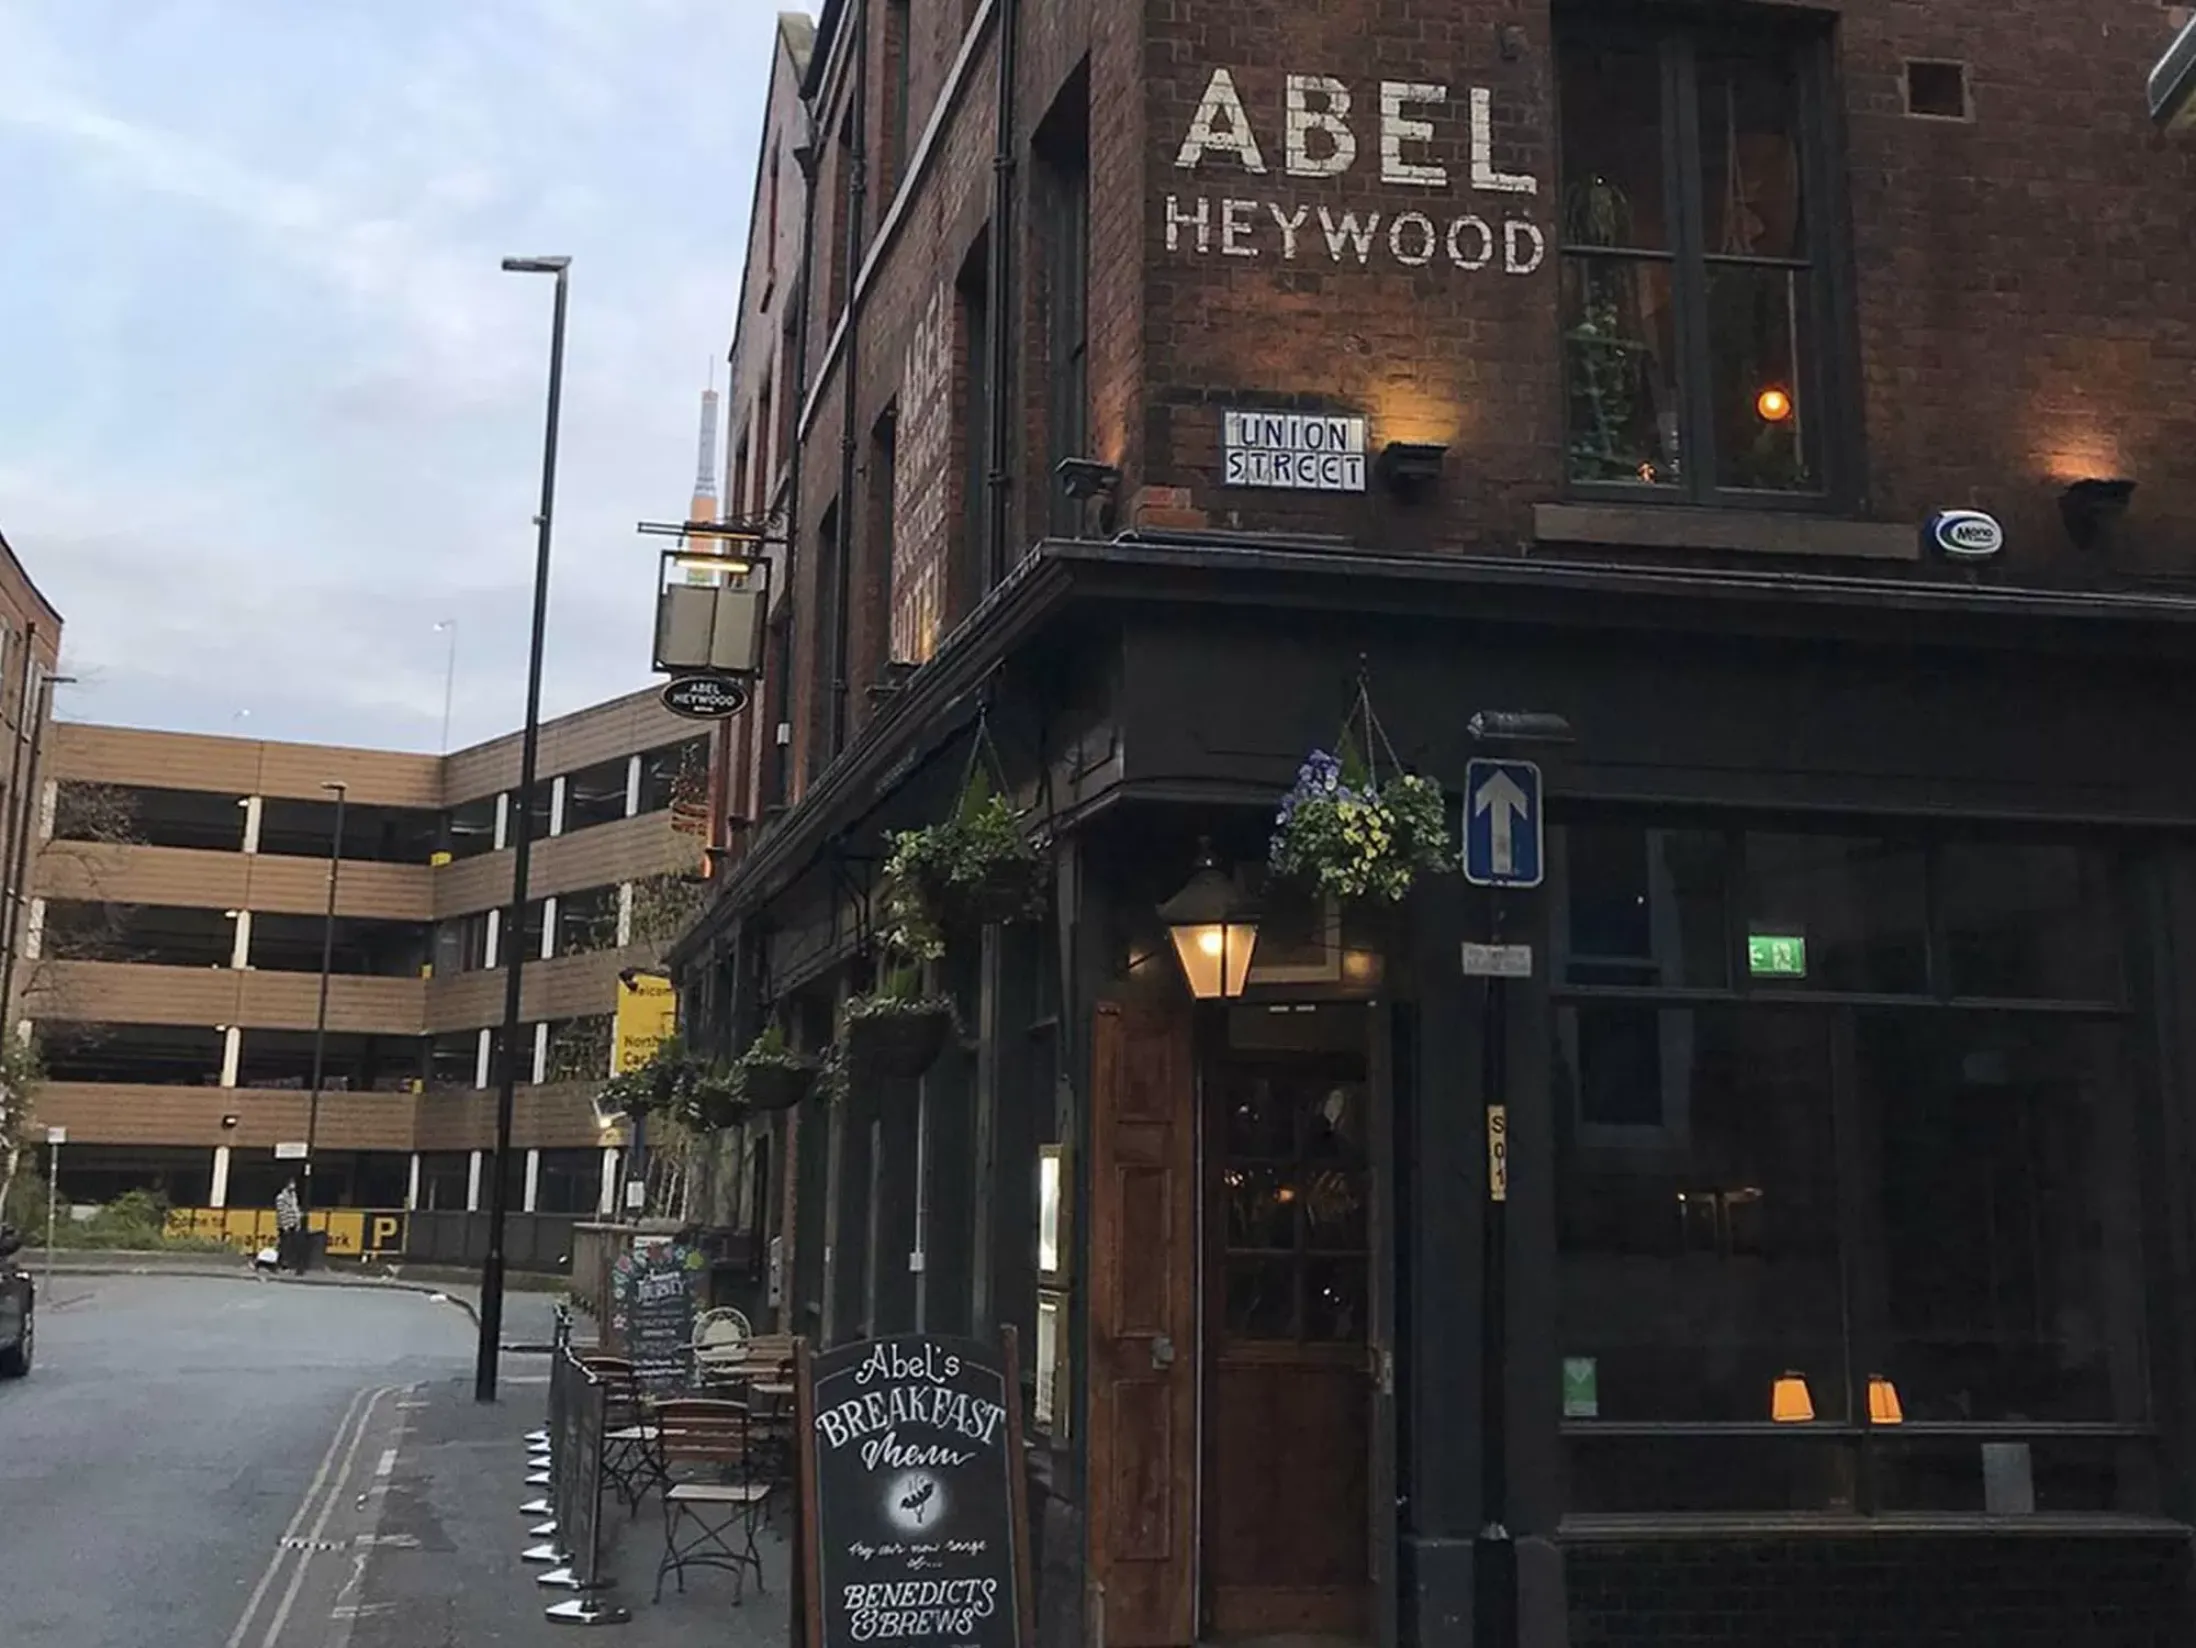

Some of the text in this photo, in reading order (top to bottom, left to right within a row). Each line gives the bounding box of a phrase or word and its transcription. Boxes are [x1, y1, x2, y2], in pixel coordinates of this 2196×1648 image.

[1174, 67, 1538, 196] ABEL
[1165, 195, 1545, 276] HEYWOOD
[1241, 415, 1348, 449] UNION
[1227, 450, 1363, 487] STREET
[672, 693, 736, 707] HEYWOOD
[690, 682, 720, 695] ABEL
[373, 1217, 398, 1249] P
[855, 1343, 960, 1384] Abel's
[815, 1385, 1006, 1449] BREAKFAST
[861, 1431, 976, 1471] Menu
[844, 1578, 997, 1617] BENEDICTS
